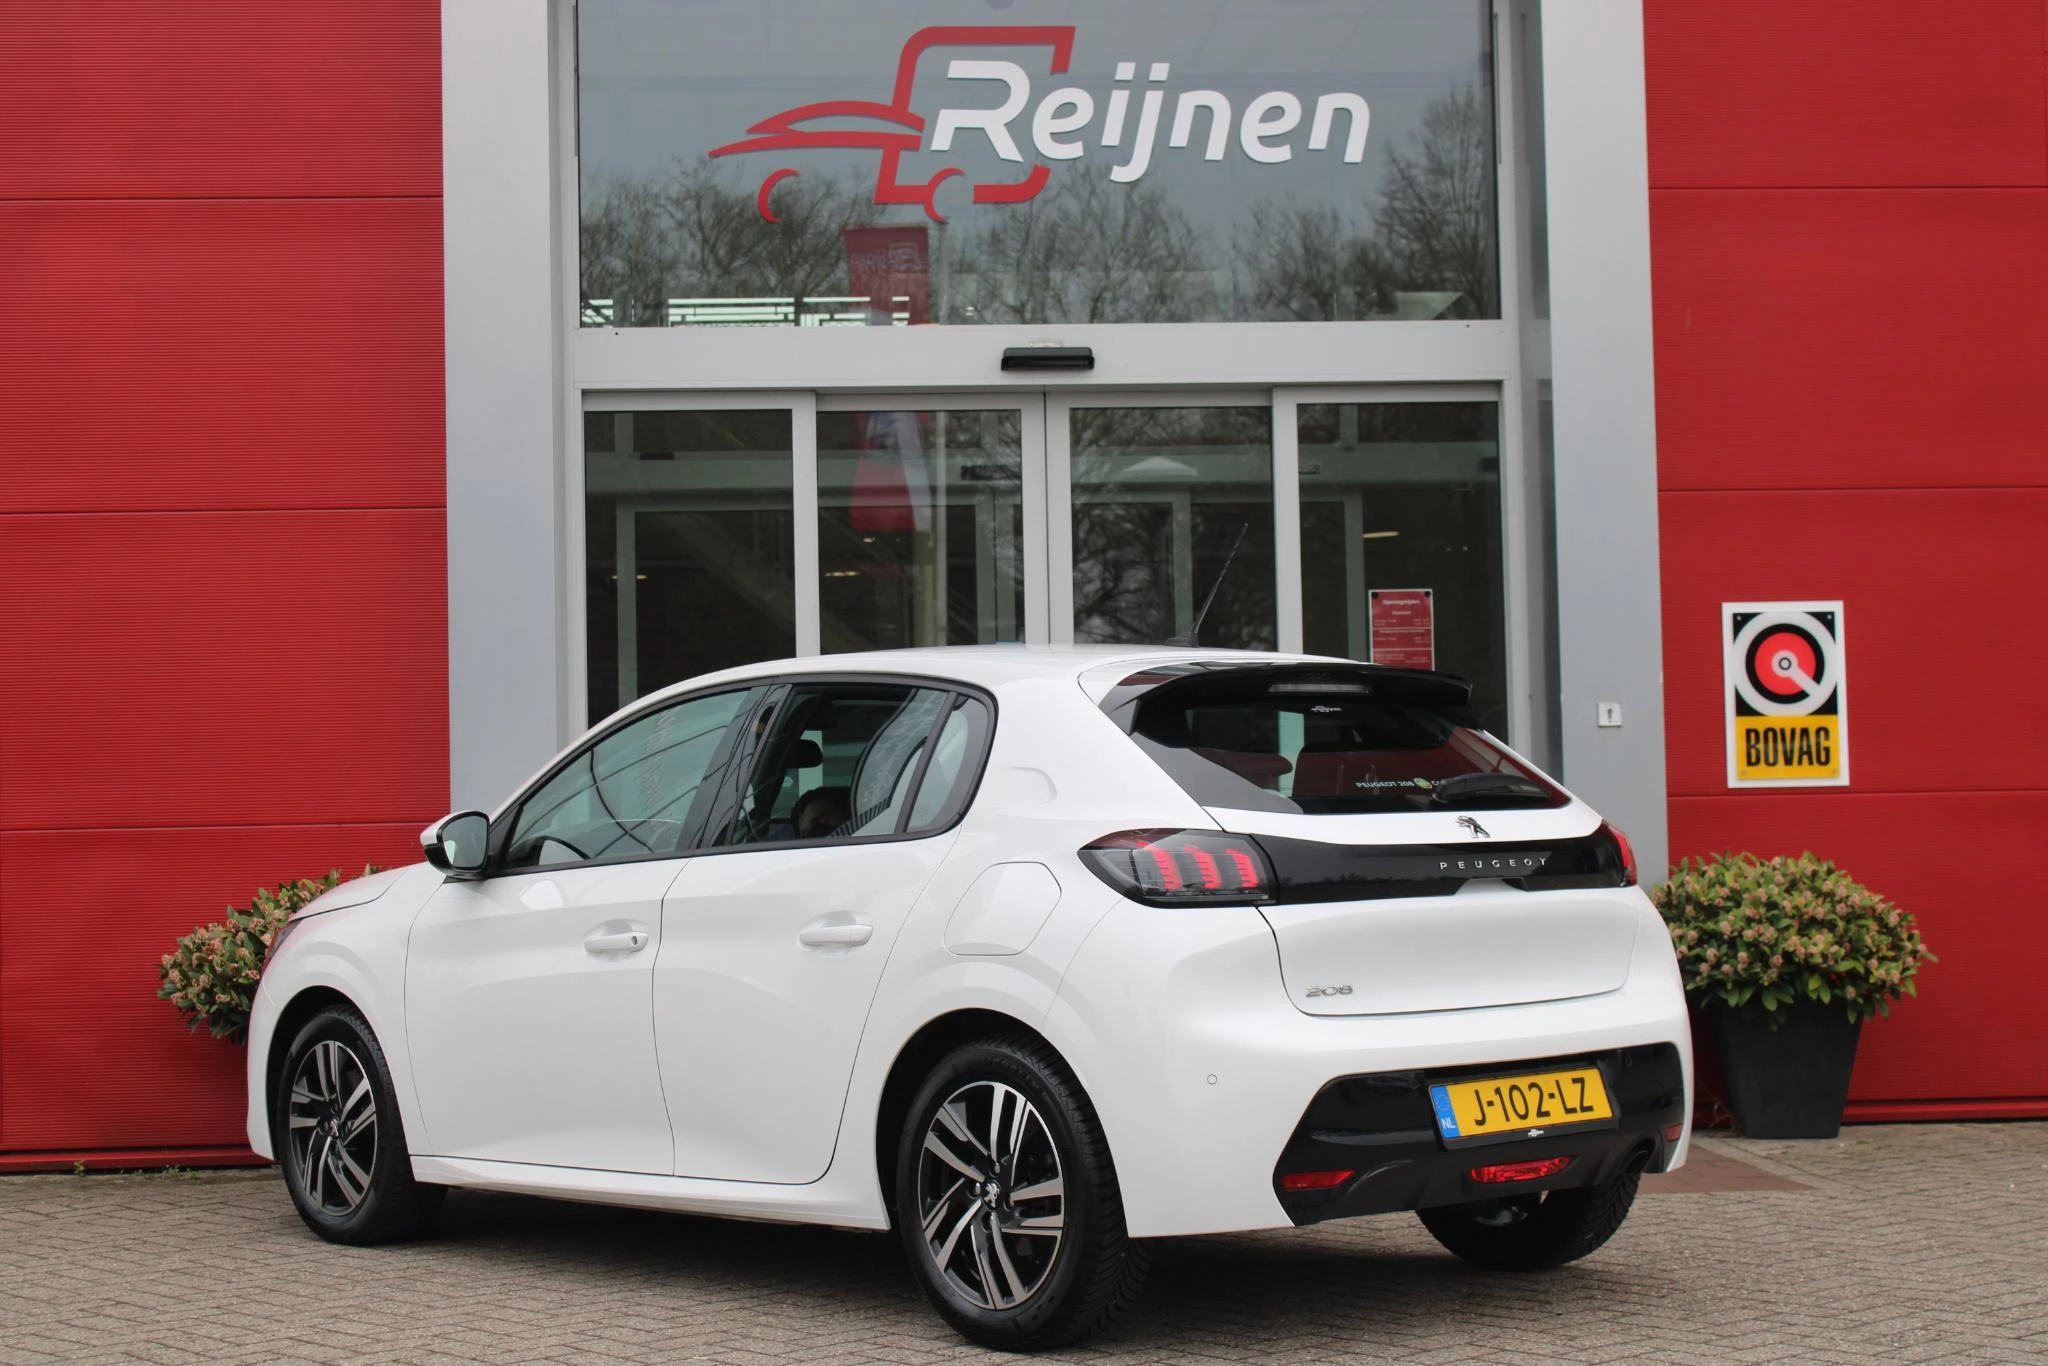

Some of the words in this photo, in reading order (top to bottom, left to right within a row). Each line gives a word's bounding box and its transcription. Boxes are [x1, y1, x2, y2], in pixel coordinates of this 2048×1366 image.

[930, 60, 1370, 183] Reijnen
[1746, 726, 1831, 767] BOVAG
[1439, 857, 1547, 869] PEUGEOT
[1306, 984, 1353, 997] 208
[1474, 1077, 1594, 1126] J-102-LZ
[1441, 1118, 1457, 1129] NL
